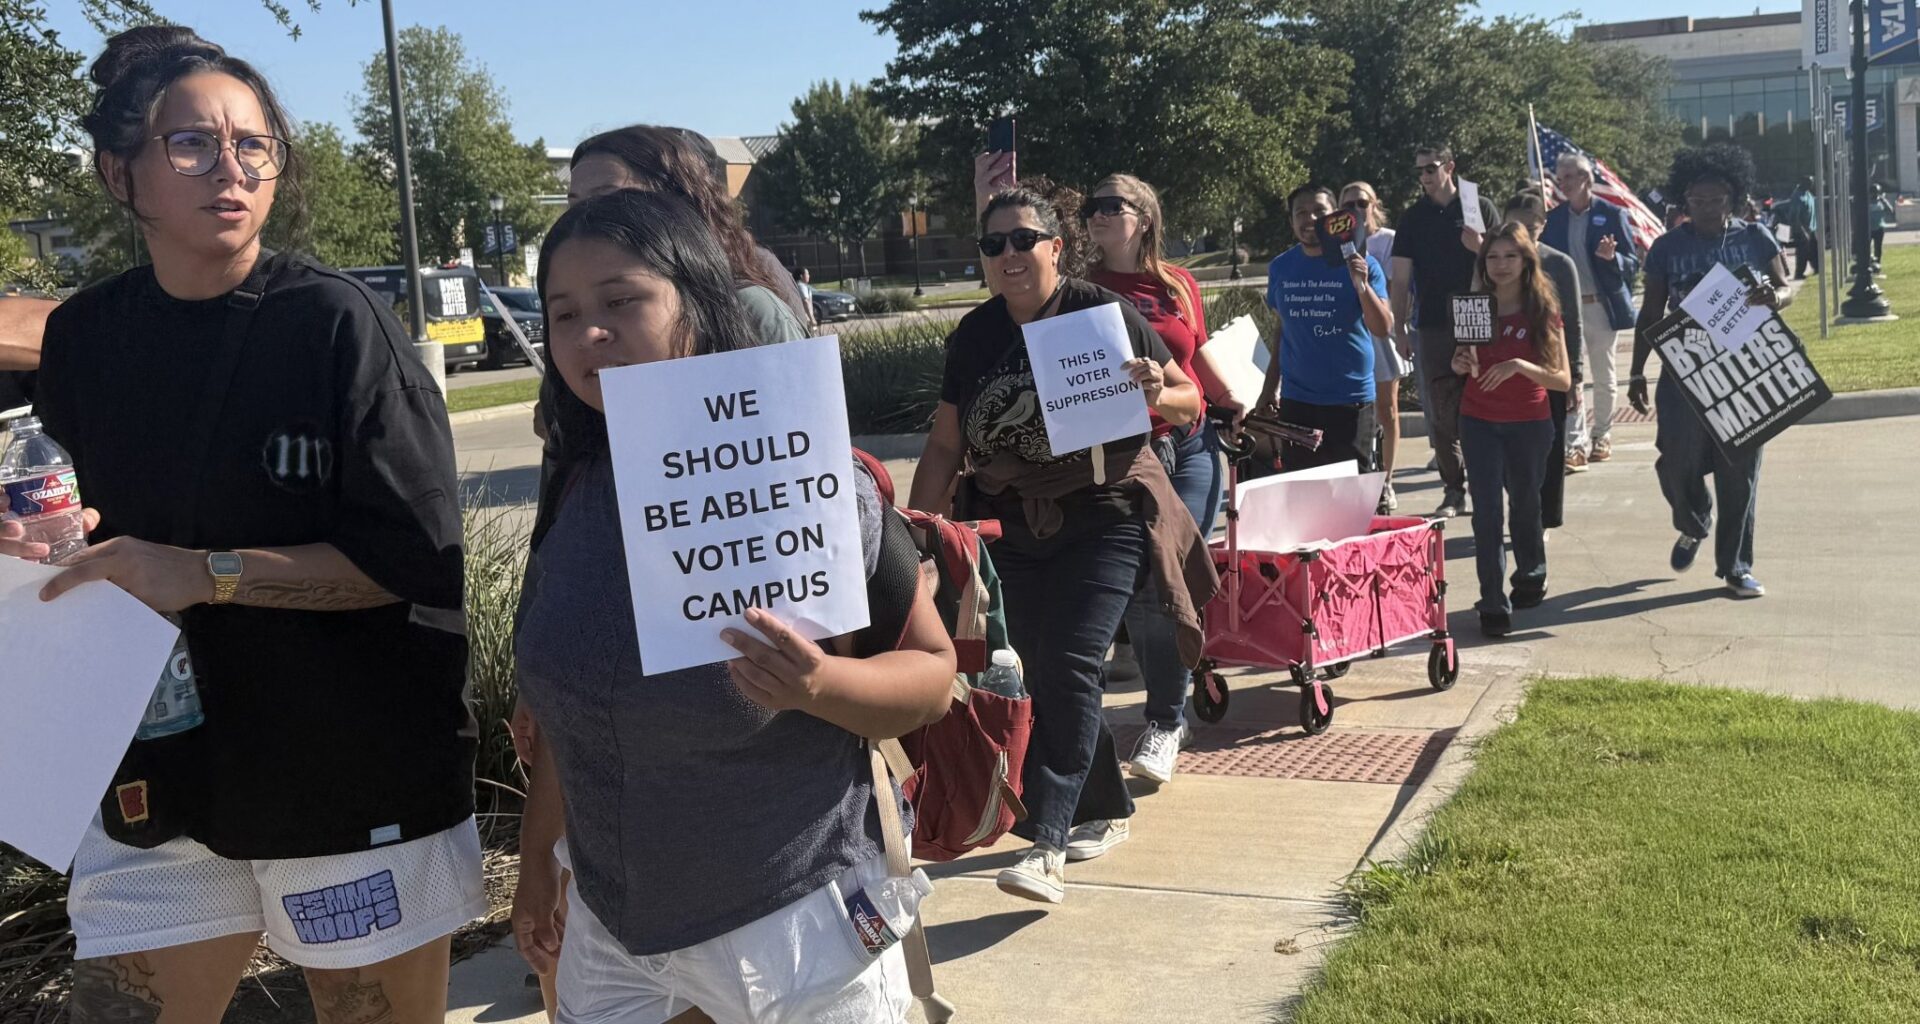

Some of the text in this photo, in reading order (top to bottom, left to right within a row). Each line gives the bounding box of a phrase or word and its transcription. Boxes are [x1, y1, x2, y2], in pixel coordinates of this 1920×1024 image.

[1817, 0, 1826, 52] ESIGNERS
[1453, 312, 1491, 326] VOTERS
[1707, 289, 1723, 305] WE
[1707, 287, 1744, 328] DESERVE
[1455, 325, 1492, 339] MATTER
[1059, 349, 1106, 370] THIS IS
[1066, 367, 1111, 387] VOTER
[1682, 319, 1794, 409] VOTERS
[704, 389, 760, 422] WE
[1046, 380, 1140, 412] SUPPRESSION
[1704, 351, 1817, 443] MATTER
[663, 431, 810, 479] SHOULD
[644, 473, 839, 532] BE ABLE TO
[672, 523, 825, 575] VOTE ON
[682, 570, 830, 621] CAMPUS
[282, 869, 396, 920] FEMME
[292, 896, 401, 944] HOOPS
[856, 912, 881, 945] OZARKA
